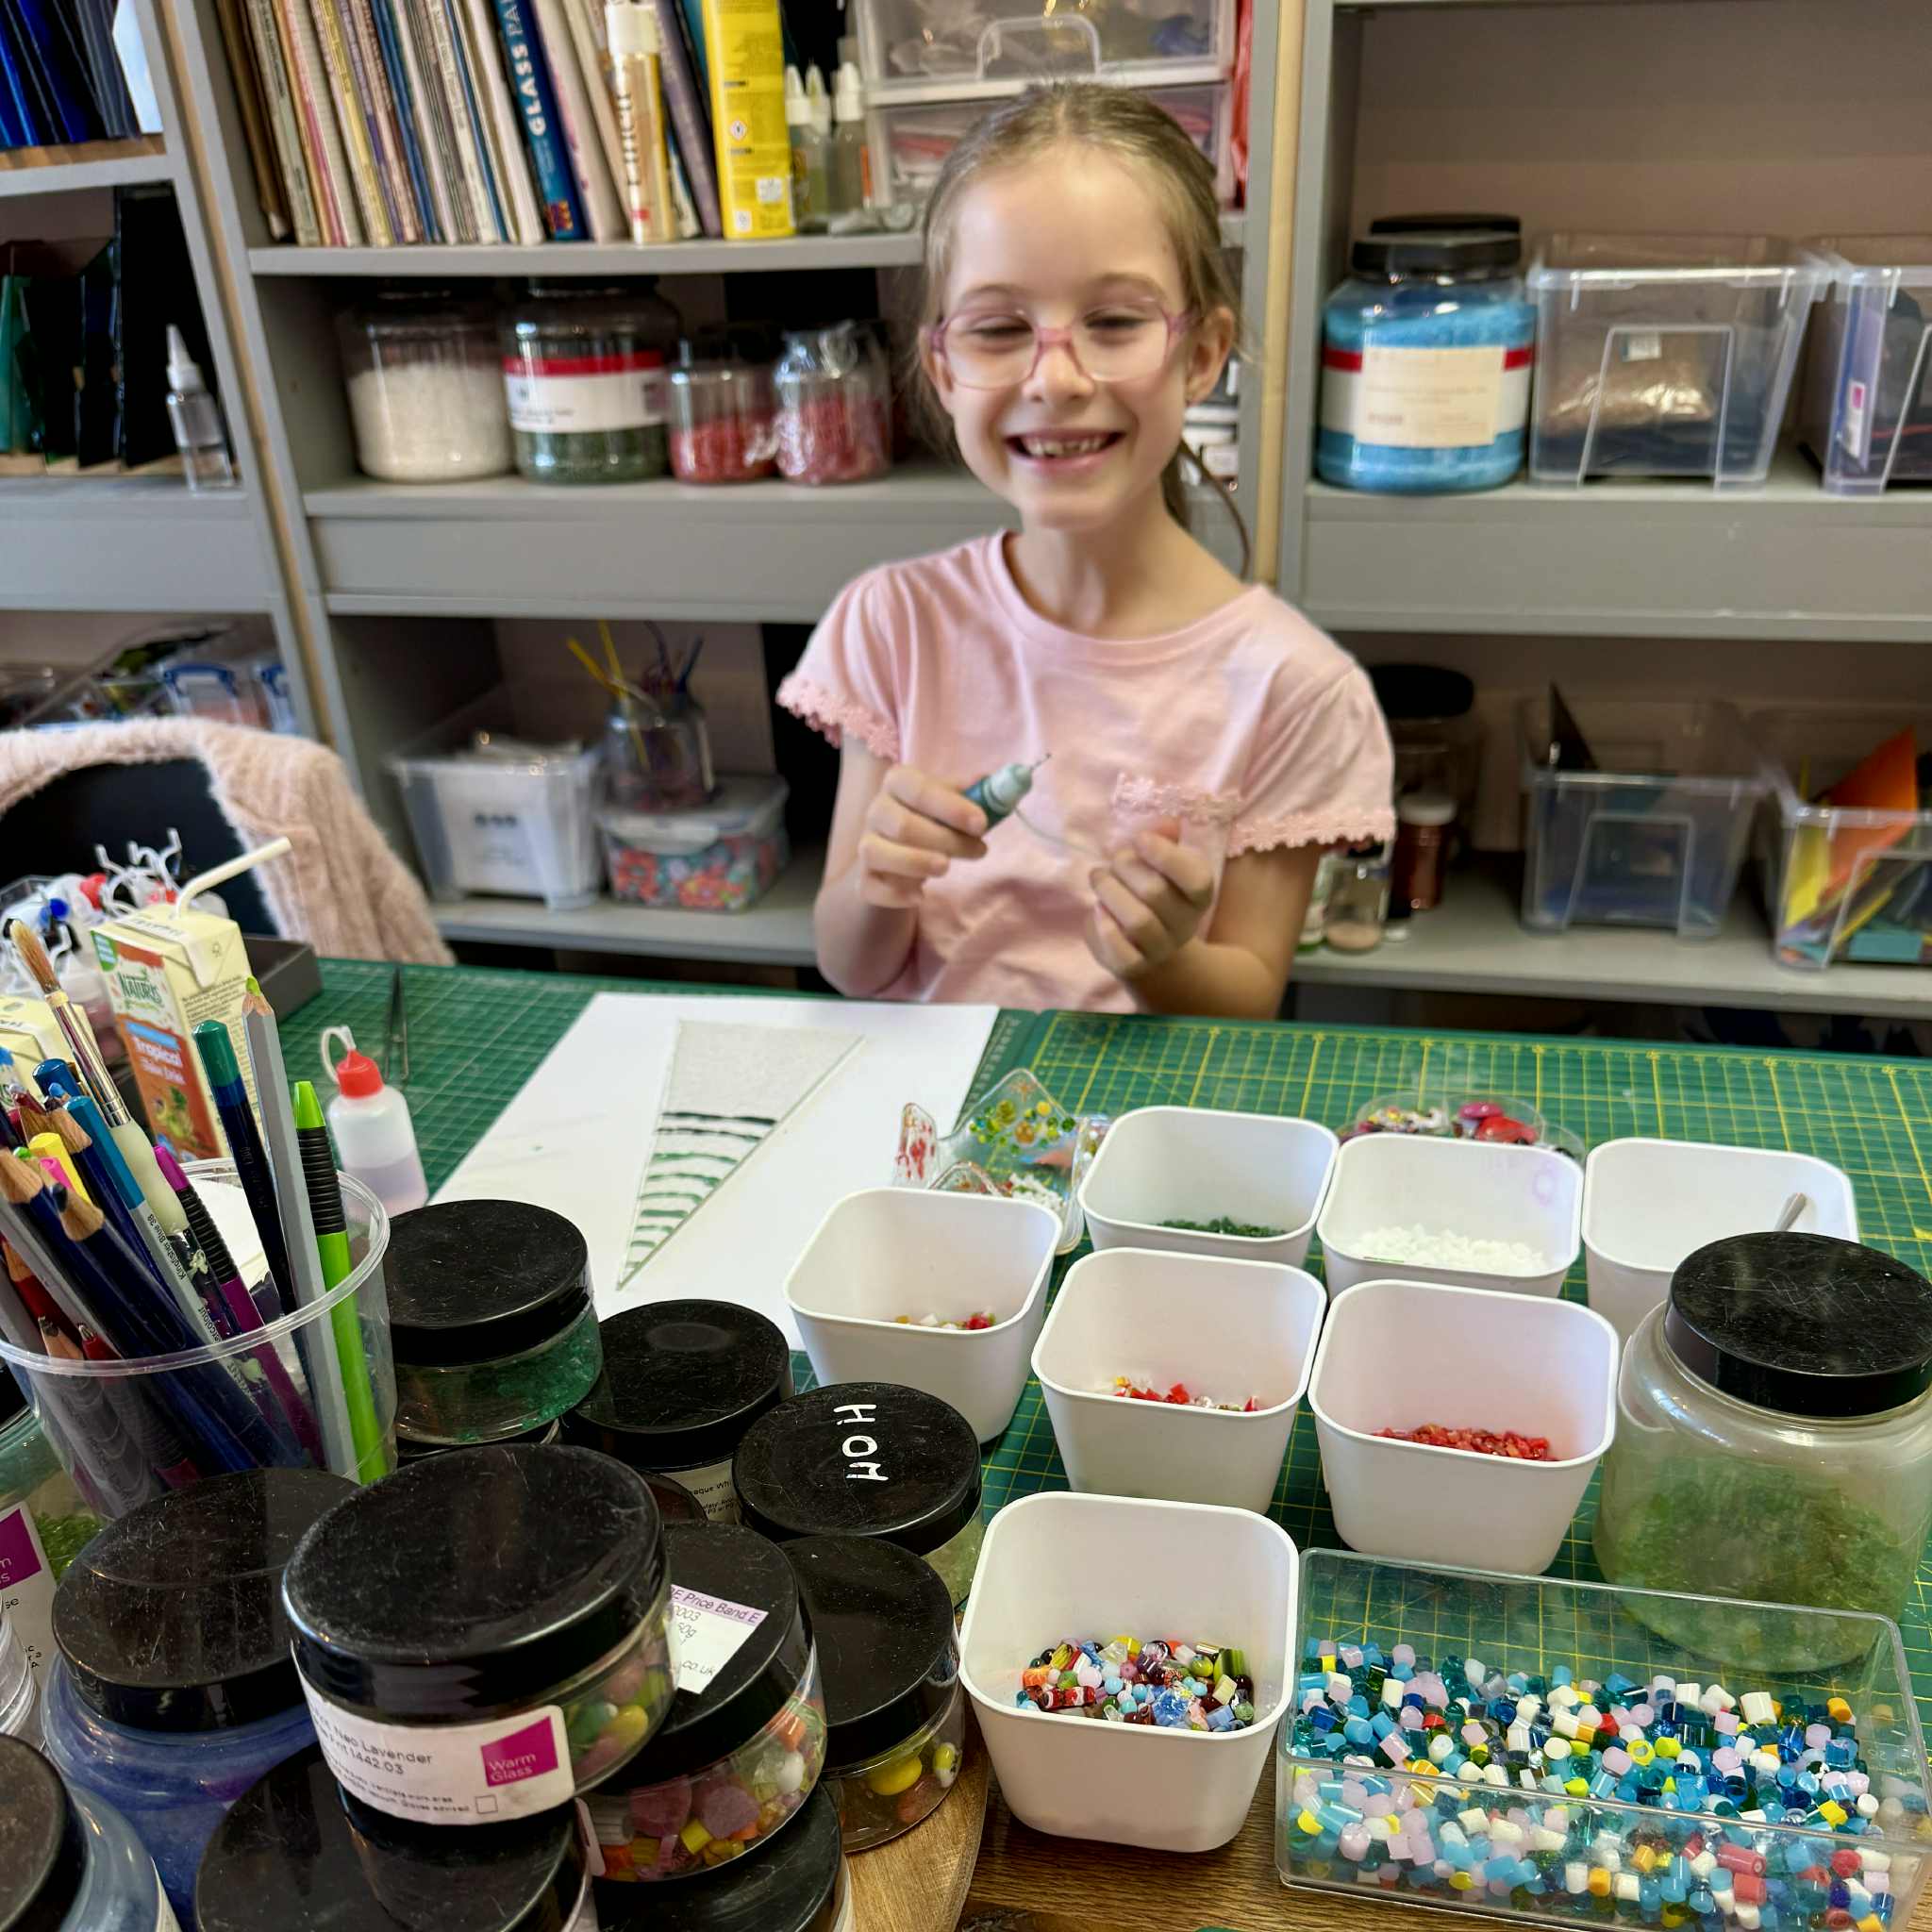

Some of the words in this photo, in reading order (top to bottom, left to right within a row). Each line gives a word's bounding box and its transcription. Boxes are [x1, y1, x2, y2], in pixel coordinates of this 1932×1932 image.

[512, 43, 546, 136] GLASS
[146, 1213, 158, 1226] 38
[153, 1224, 167, 1244] Blue
[198, 1307, 222, 1342] ercolour
[693, 1485, 714, 1495] aque
[683, 1592, 714, 1609] Price
[715, 1603, 748, 1621] Band
[748, 1612, 761, 1624] E
[350, 1746, 405, 1774] 1442.03
[360, 1740, 433, 1767] Lavender
[489, 1754, 537, 1772] Warm
[491, 1766, 534, 1782] Glass
